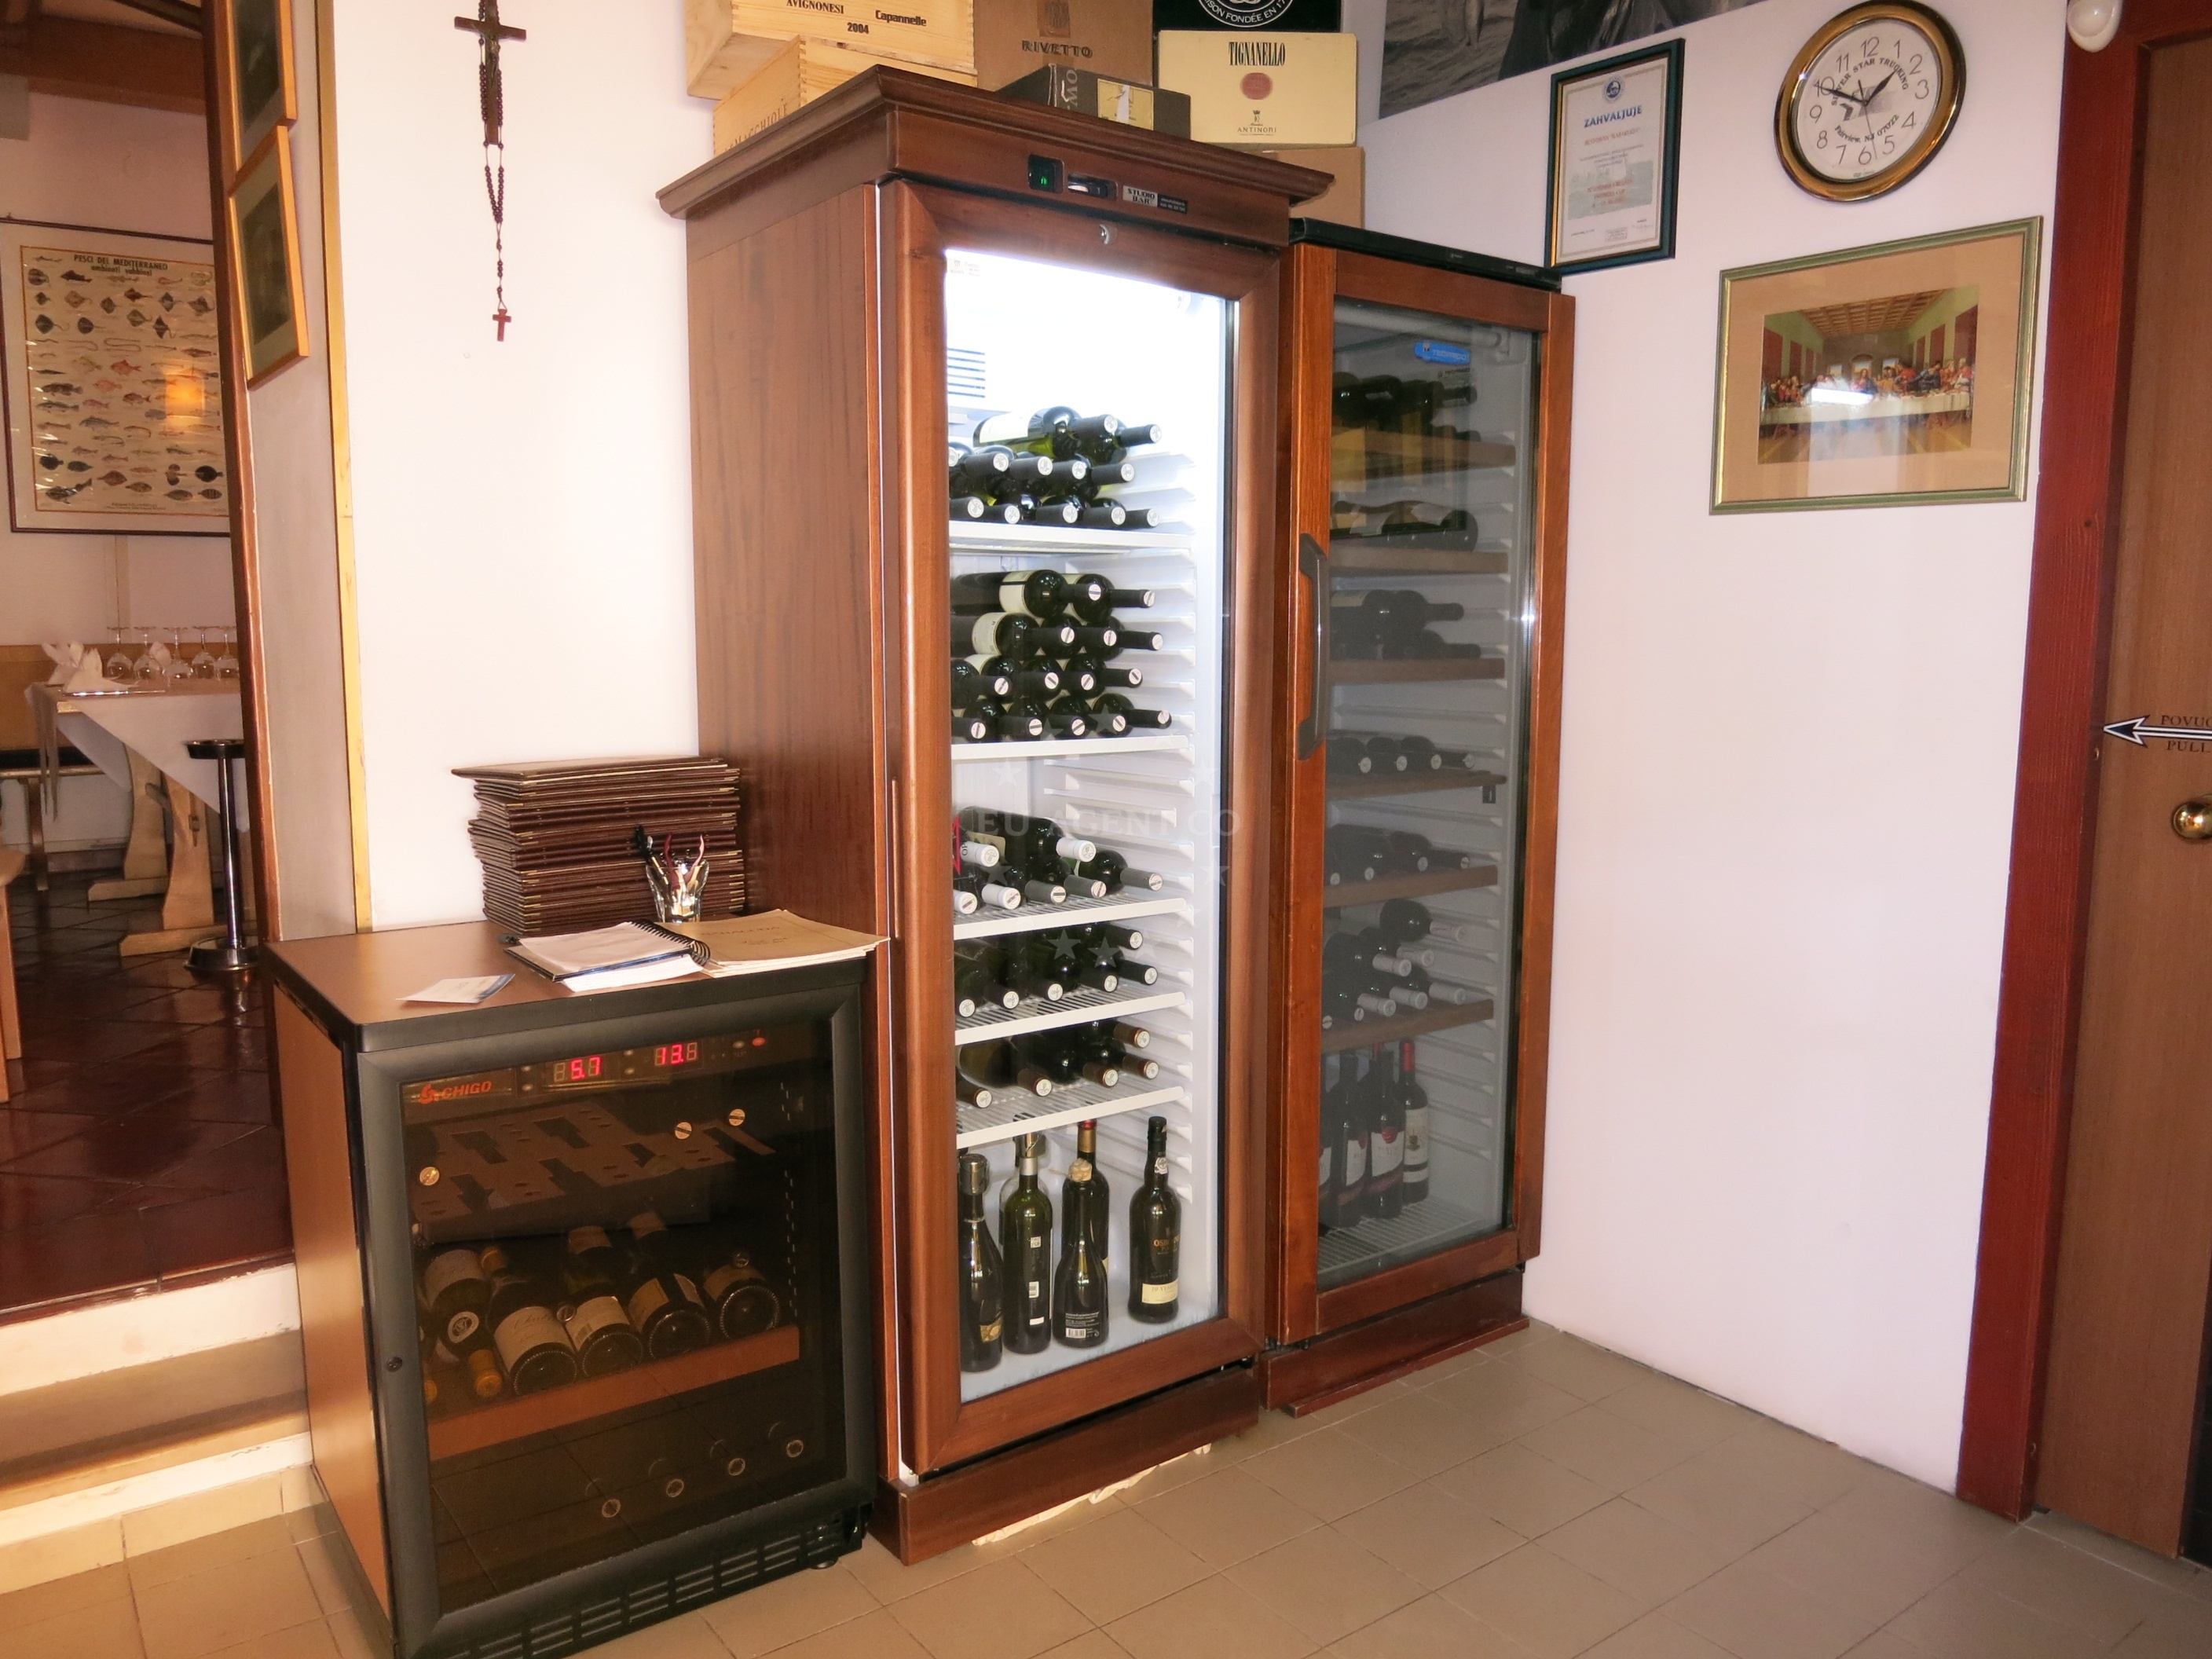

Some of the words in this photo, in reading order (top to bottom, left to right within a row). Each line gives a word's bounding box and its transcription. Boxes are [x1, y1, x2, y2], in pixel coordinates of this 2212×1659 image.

[786, 0, 844, 14] AVIGNONESI
[1225, 12, 1264, 24] FONDÉE
[1263, 7, 1277, 18] EN
[875, 9, 927, 27] Capannelle
[847, 22, 870, 35] 2004
[1021, 40, 1093, 59] RIVETTO
[1229, 42, 1286, 66] TIGNANELLO
[1861, 36, 1880, 58] 12
[1894, 39, 1901, 59] 1
[1836, 53, 1850, 73] 11
[1852, 57, 1875, 73] STAR
[1909, 53, 1923, 75] 2
[1815, 76, 1835, 97] 10
[1914, 79, 1930, 100] 3
[1584, 104, 1643, 128] ZAHVALJUJE
[1809, 104, 1822, 124] 9
[1901, 111, 1917, 130] 4
[1816, 130, 1828, 149] 8
[1882, 134, 1895, 156] 5
[1836, 145, 1848, 165] 7
[1858, 146, 1872, 166] 6
[1127, 188, 1155, 200] STUDIO
[74, 254, 94, 263] PESCI
[113, 258, 168, 271] MEDITERRANEO
[2166, 741, 2211, 753] PULL
[441, 1080, 493, 1098] CHIGO
